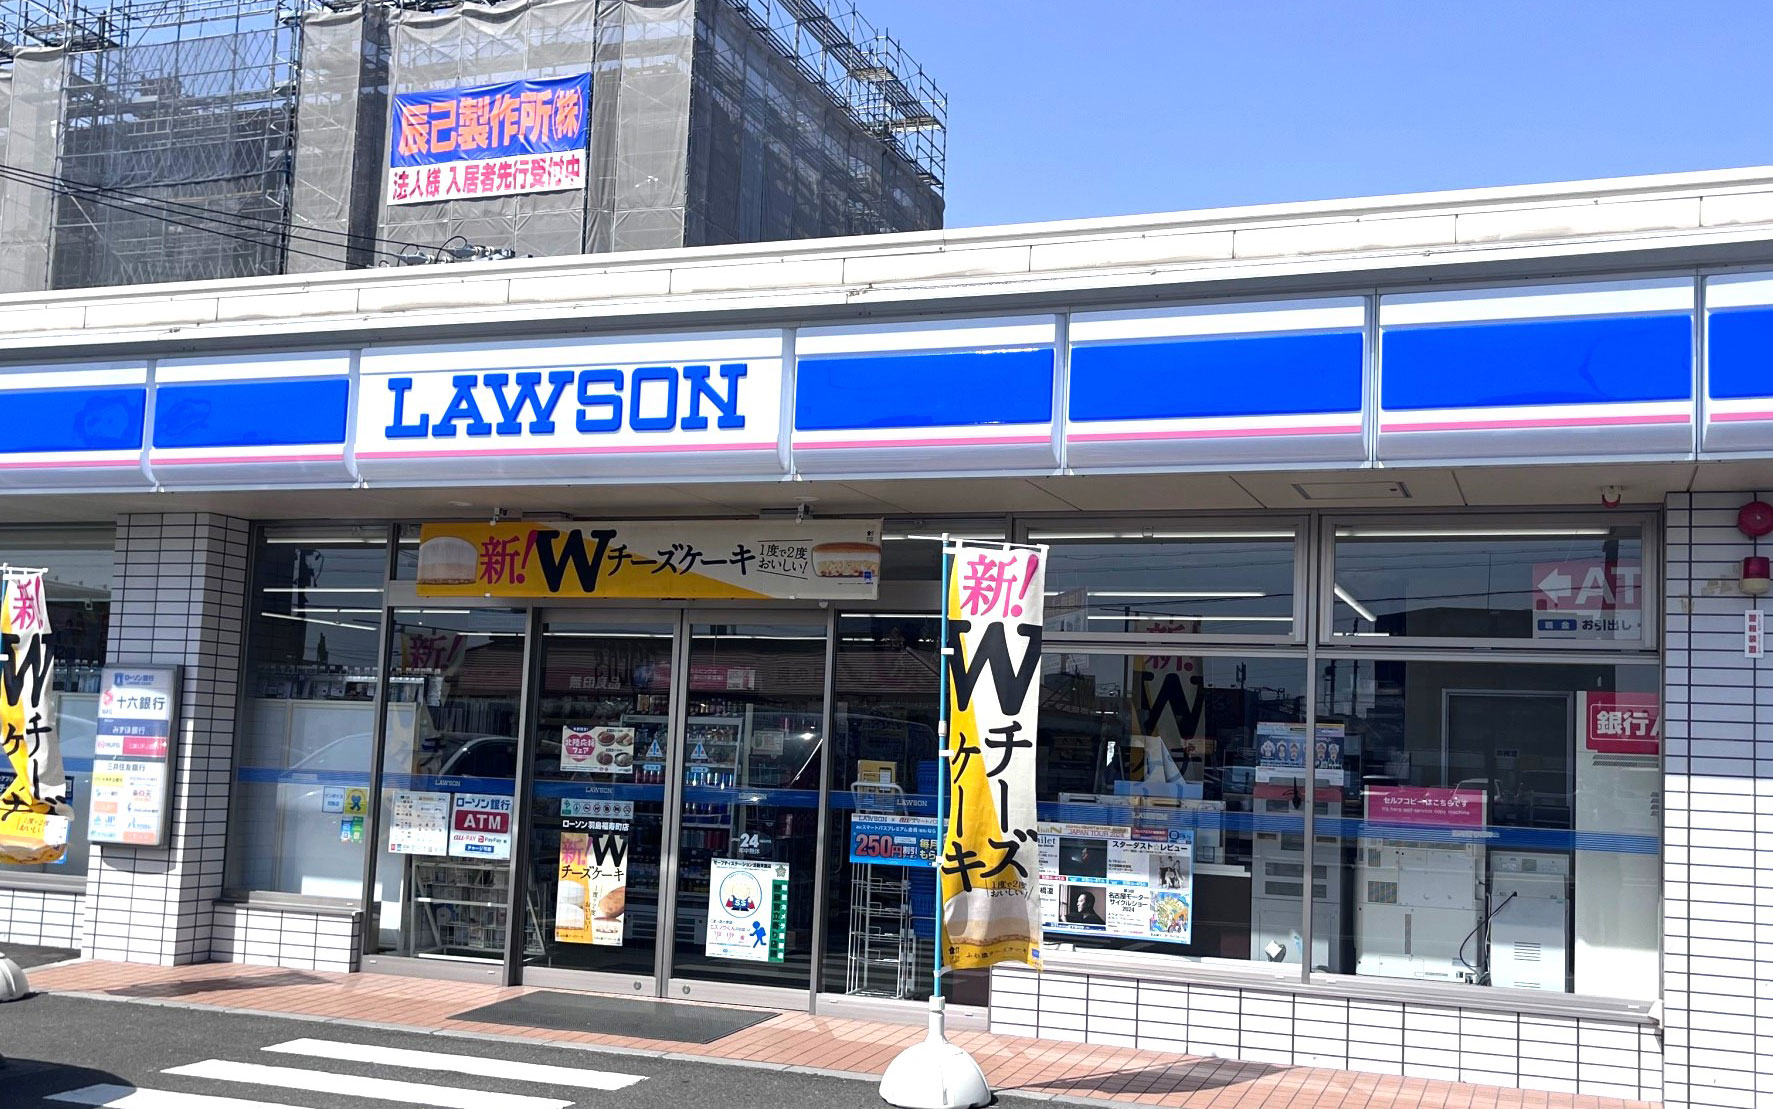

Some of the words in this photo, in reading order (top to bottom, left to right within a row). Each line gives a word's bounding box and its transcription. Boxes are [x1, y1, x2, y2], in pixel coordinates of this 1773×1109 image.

[393, 167, 441, 200] 法人様
[446, 154, 580, 196] 入居者先行受付中
[385, 363, 748, 438] LAWSON
[759, 543, 808, 560] 1度で2度
[535, 528, 618, 593] W
[606, 543, 757, 577] チーズケーキ
[758, 557, 808, 574] おいしい!
[960, 553, 1040, 618] 新!
[949, 620, 1042, 716] W
[117, 696, 165, 710] 十六銀行
[112, 726, 146, 735] みずほ銀行
[107, 763, 146, 771] 三井住友銀行
[456, 797, 511, 810] ローソン銀行
[896, 799, 928, 807] LAWSON
[980, 720, 1038, 878] チーズ
[1384, 797, 1469, 807] セルフコピーはこちらです
[941, 732, 987, 892] ケーキ
[463, 813, 502, 830] ATM
[740, 832, 760, 848] 24
[561, 865, 624, 881] チーズケーキ
[1108, 891, 1150, 900] 名古屋モーター
[1109, 899, 1149, 907] サイクルショー
